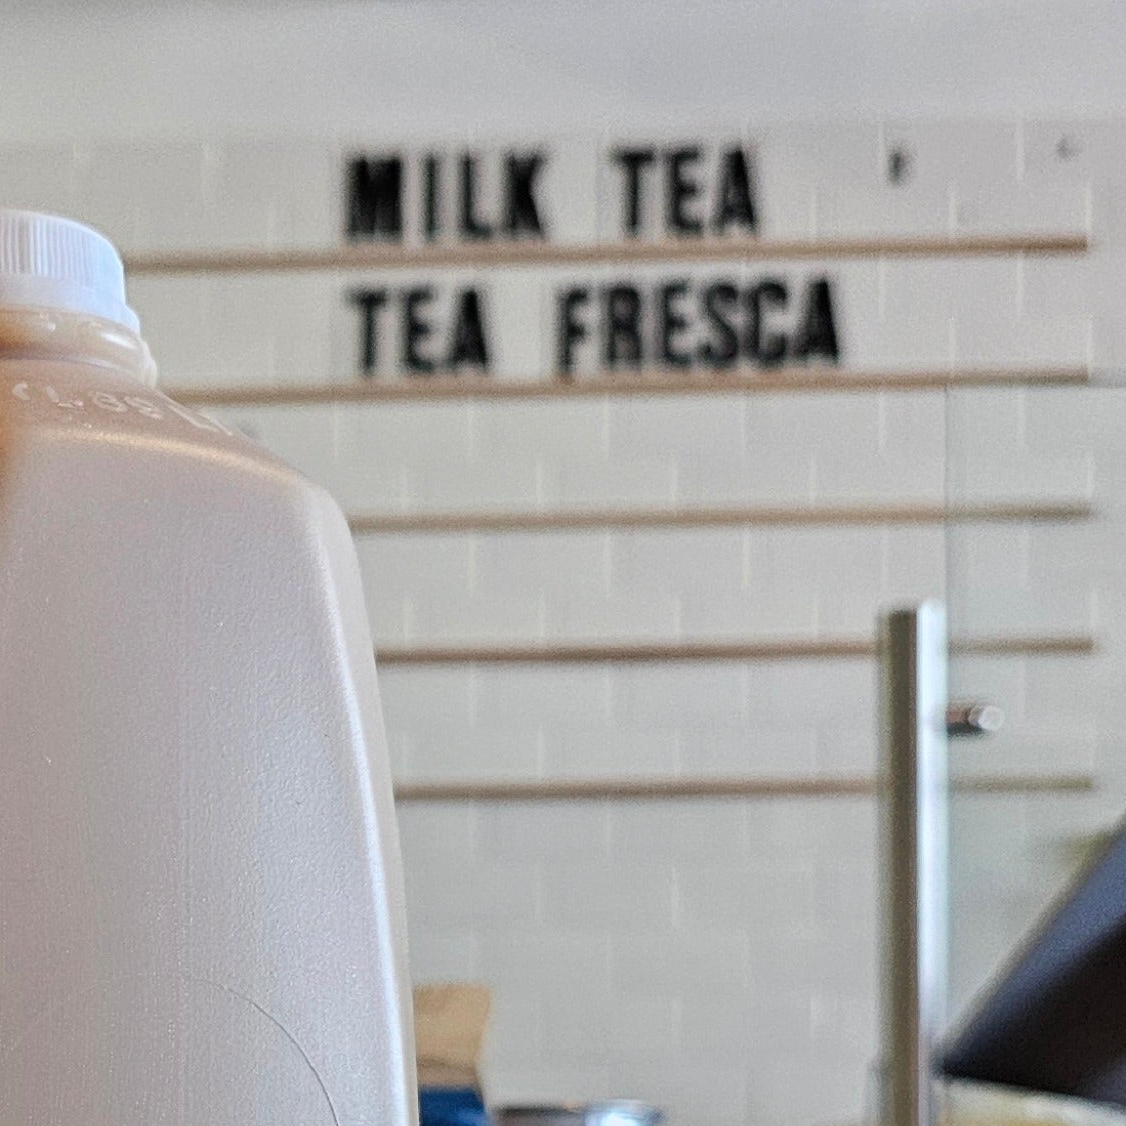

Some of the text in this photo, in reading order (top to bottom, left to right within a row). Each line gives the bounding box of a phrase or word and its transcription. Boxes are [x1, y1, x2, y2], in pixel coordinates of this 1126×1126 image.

[344, 146, 759, 242] MILK TEA
[348, 275, 840, 378] TEA FRESCA
